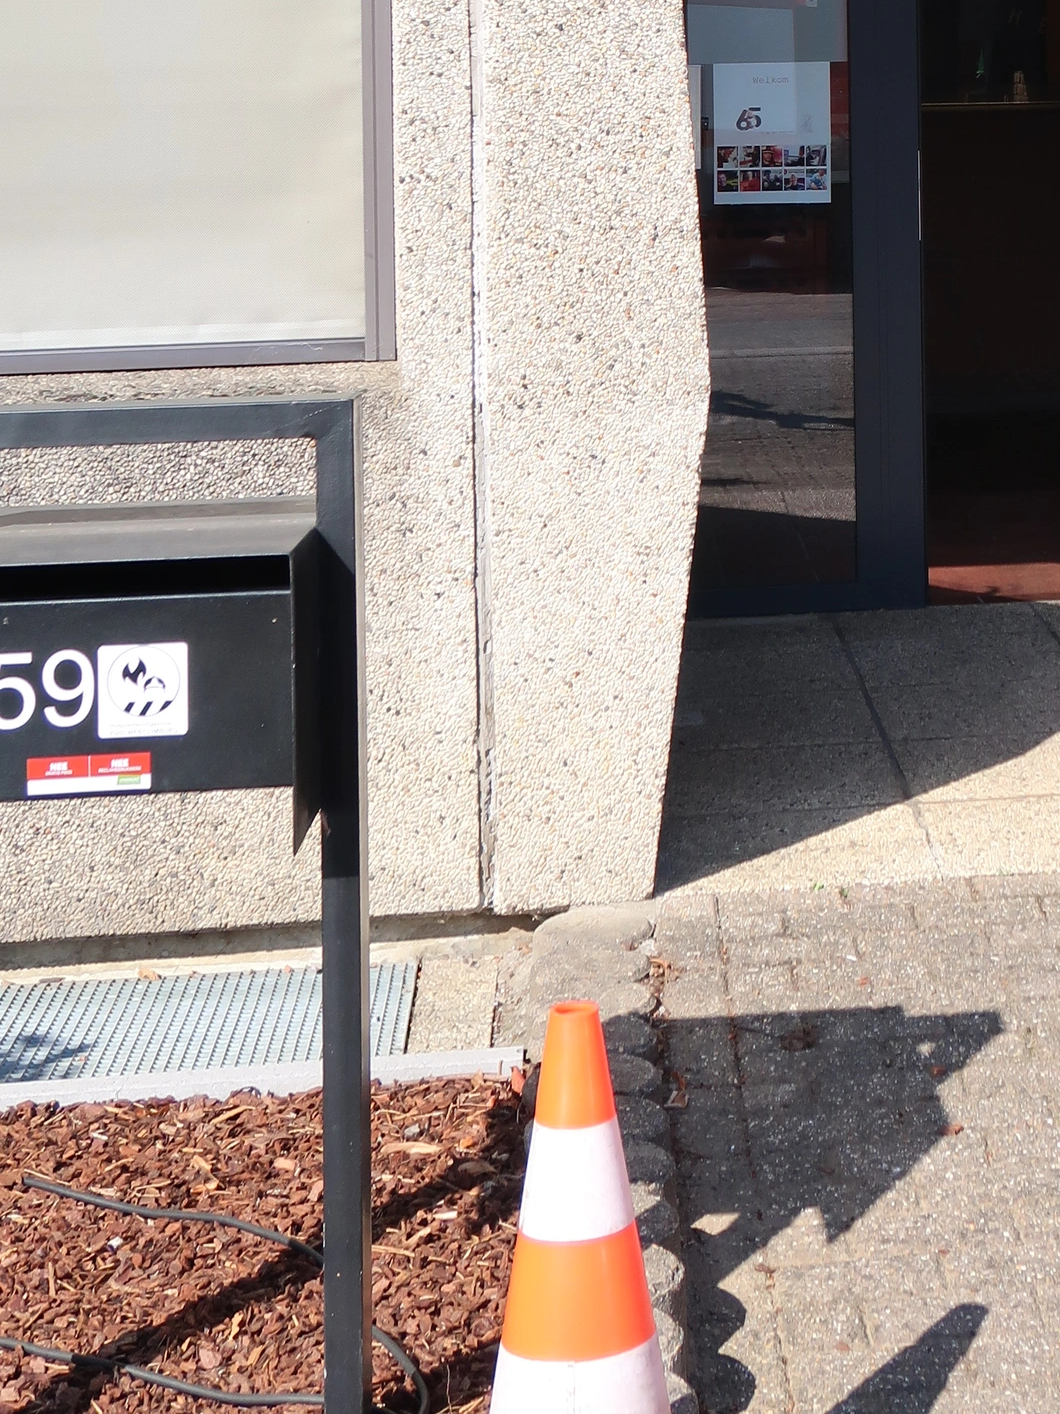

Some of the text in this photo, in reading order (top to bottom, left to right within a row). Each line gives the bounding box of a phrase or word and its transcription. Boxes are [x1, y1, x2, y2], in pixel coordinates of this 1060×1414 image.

[752, 76, 789, 84] Welkom
[0, 649, 95, 731] 59
[111, 757, 129, 768] NEE
